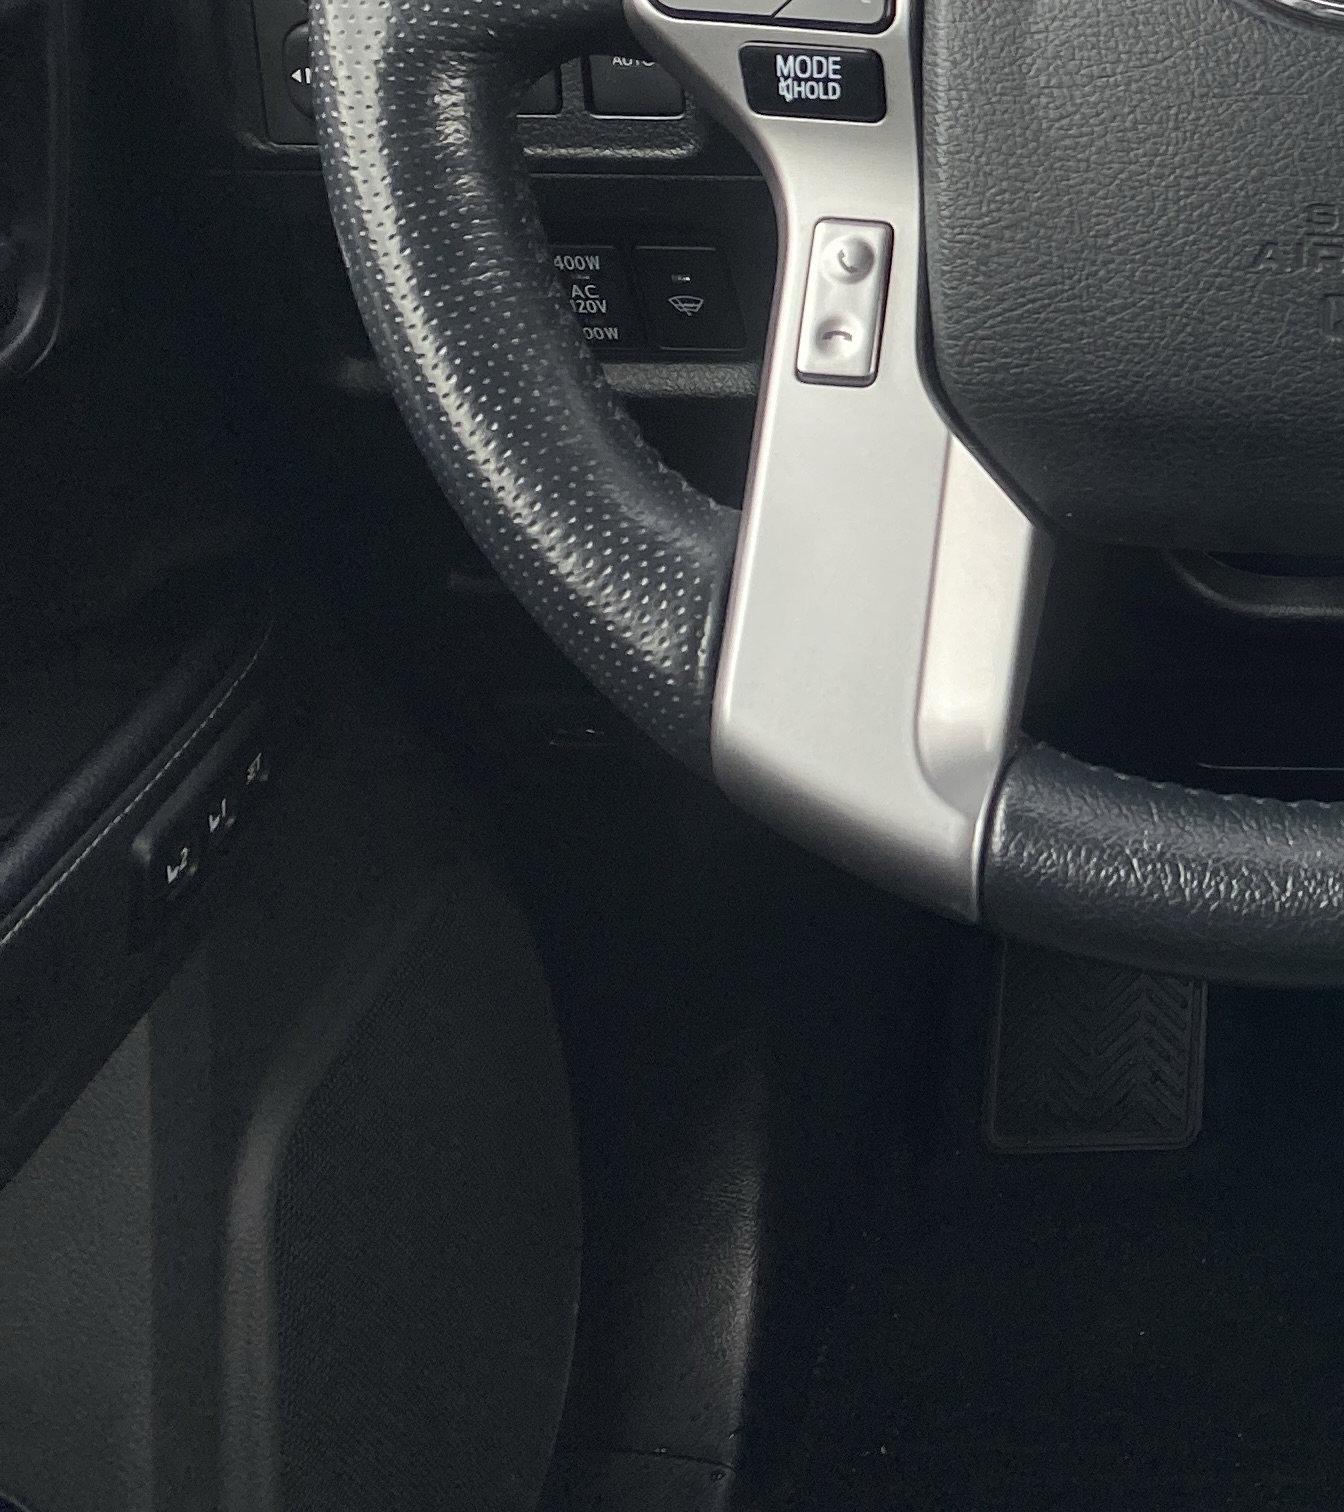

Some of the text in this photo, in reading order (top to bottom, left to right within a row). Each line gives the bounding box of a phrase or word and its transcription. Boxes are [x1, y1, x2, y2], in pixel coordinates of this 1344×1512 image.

[776, 53, 841, 81] MODE
[793, 79, 841, 101] HOLD
[553, 255, 600, 271] 400W
[571, 284, 600, 299] AC
